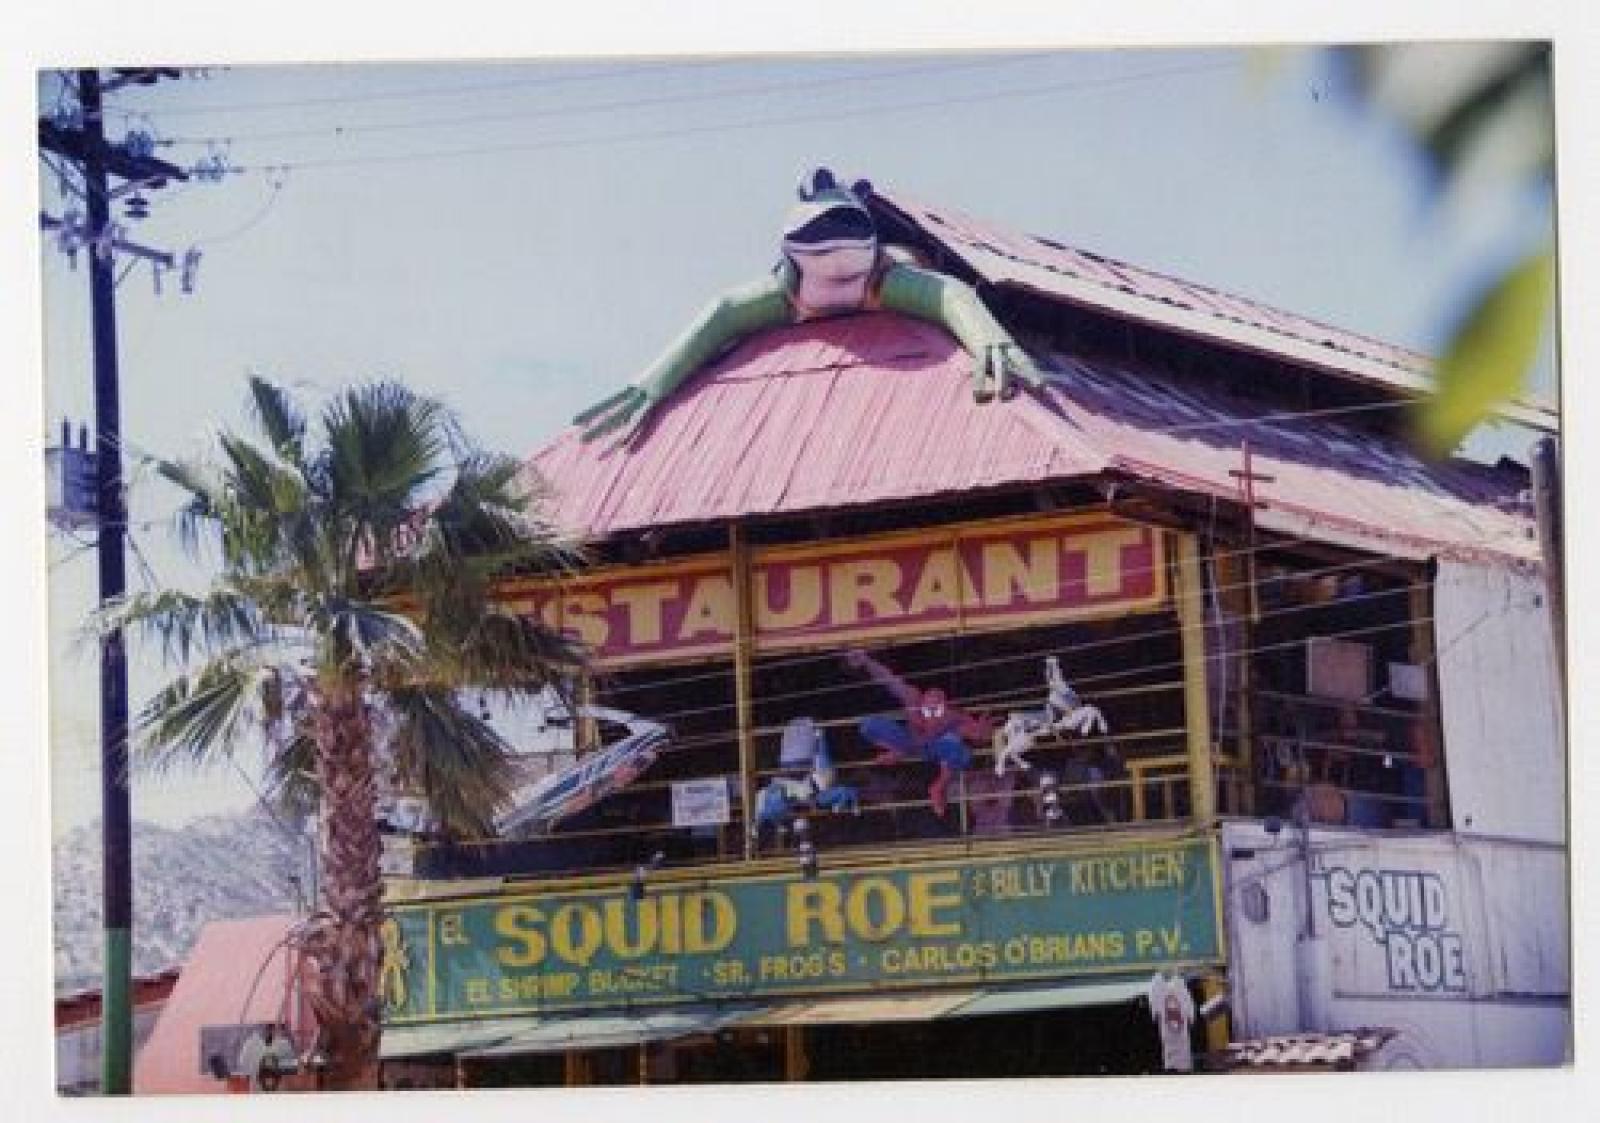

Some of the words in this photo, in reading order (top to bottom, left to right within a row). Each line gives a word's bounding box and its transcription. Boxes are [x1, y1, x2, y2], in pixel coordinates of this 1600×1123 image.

[1071, 851, 1185, 896] KITCHEN
[494, 890, 737, 967] SQUID
[785, 870, 961, 945] ROE
[1327, 866, 1447, 946] SQUID
[881, 943, 997, 973] CARLOS
[1004, 931, 1126, 963] O'BRIANS
[1385, 930, 1466, 993] ROE
